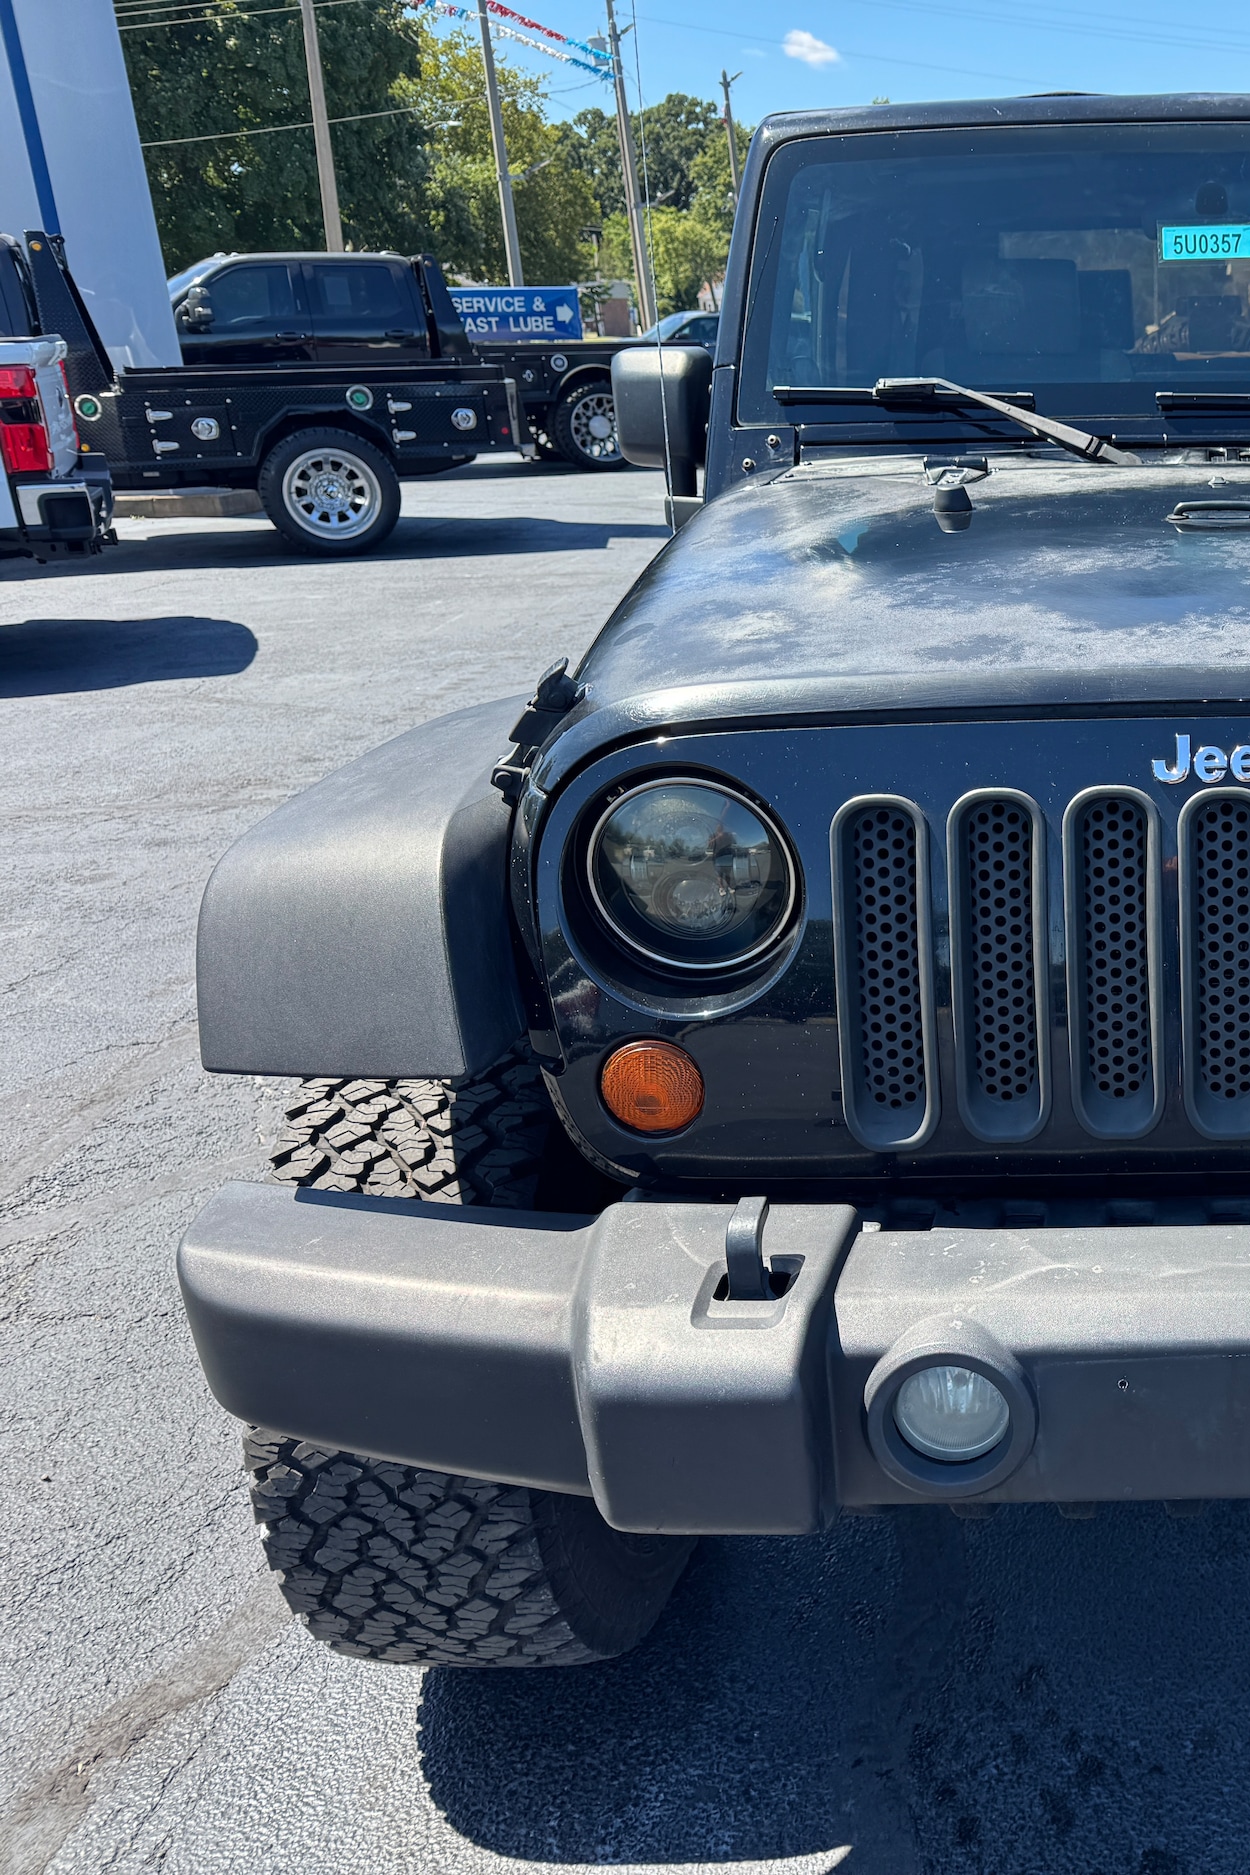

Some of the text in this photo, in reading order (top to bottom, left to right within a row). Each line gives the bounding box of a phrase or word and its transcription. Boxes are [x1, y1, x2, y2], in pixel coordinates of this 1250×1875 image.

[1173, 233, 1242, 255] 5U0357
[451, 296, 546, 313] SERVICE &
[460, 316, 555, 333] AST LUBE
